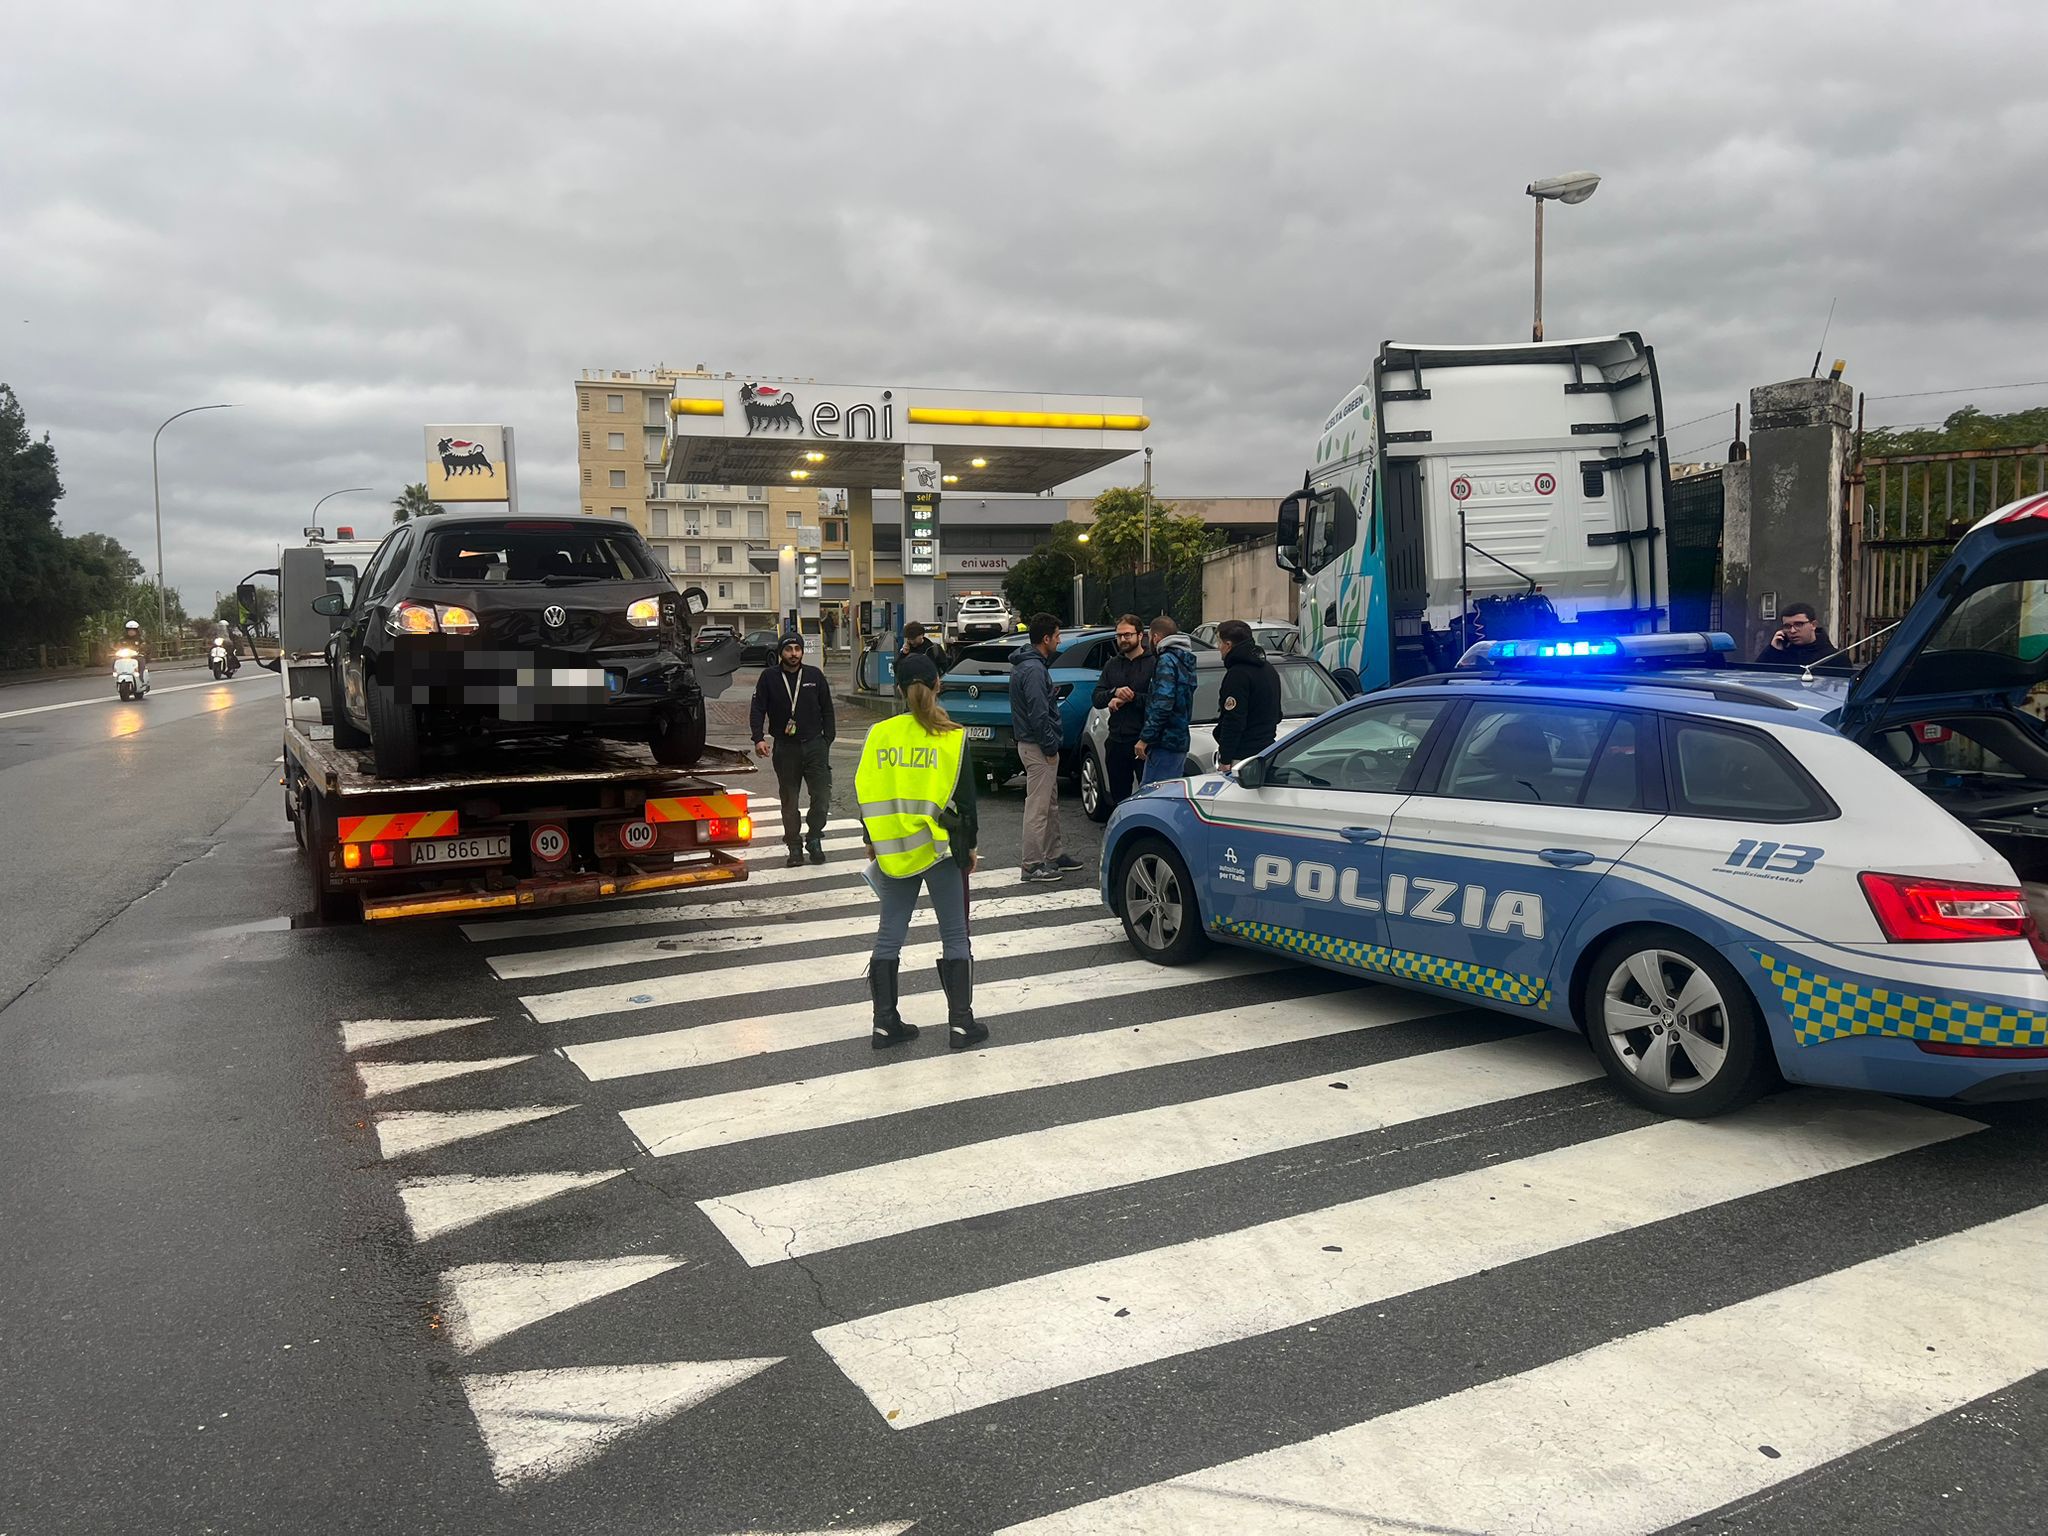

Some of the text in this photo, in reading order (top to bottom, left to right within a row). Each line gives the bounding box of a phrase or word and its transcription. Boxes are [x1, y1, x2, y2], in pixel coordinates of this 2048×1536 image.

[1343, 394, 1364, 417] GREEN
[811, 390, 893, 440] eni
[1455, 485, 1466, 494] 70
[1471, 479, 1535, 495] IVECO
[1539, 479, 1551, 489] 80
[916, 493, 932, 501] self
[961, 557, 1008, 568] eni wash
[876, 746, 938, 770] POLIZIA
[627, 826, 650, 842] 100
[415, 838, 507, 863] AD 866 LC
[540, 835, 559, 851] 90
[1724, 838, 1825, 875] 113
[1252, 854, 1546, 940] POLIZIA
